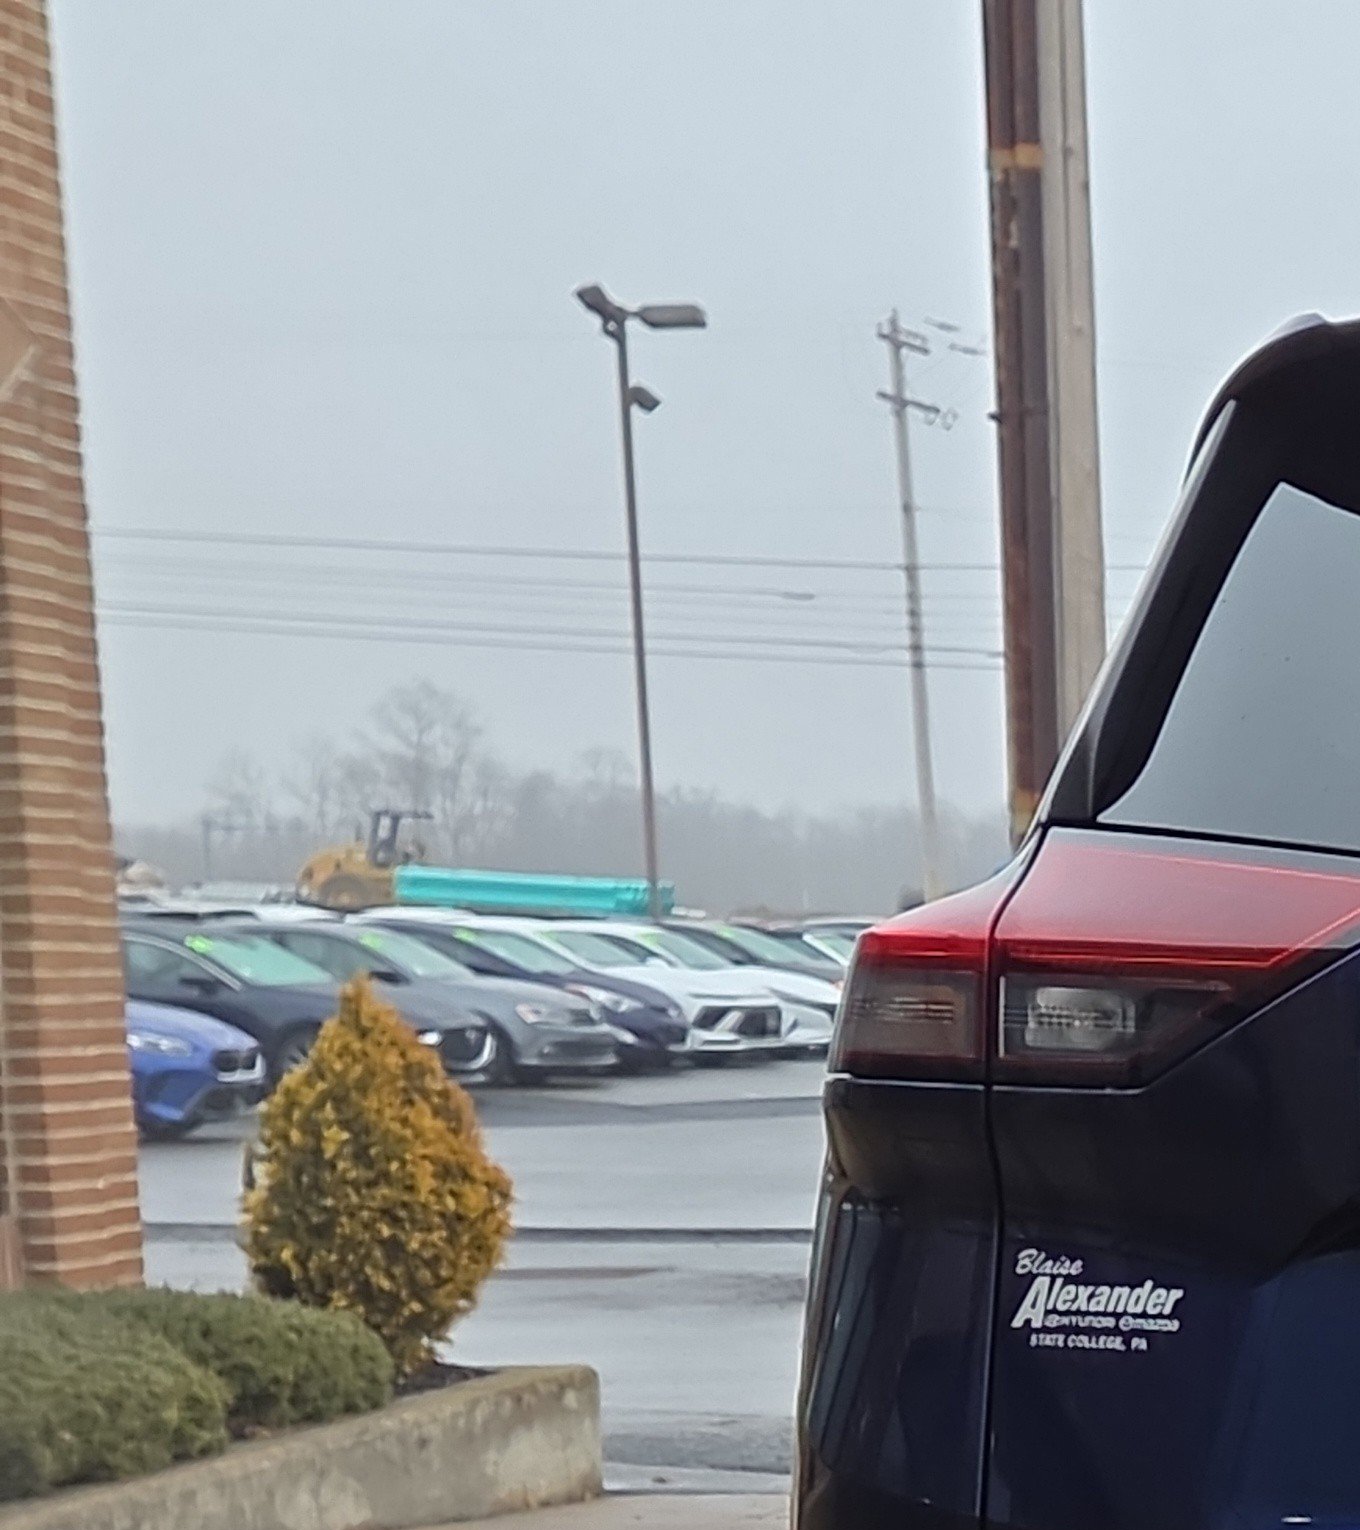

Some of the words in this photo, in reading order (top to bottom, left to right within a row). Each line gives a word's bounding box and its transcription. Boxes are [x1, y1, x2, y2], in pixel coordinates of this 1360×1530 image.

[1015, 1248, 1083, 1275] Blaise
[1010, 1275, 1184, 1328] Alexander
[1029, 1333, 1065, 1348] STATE
[1130, 1336, 1148, 1351] PA
